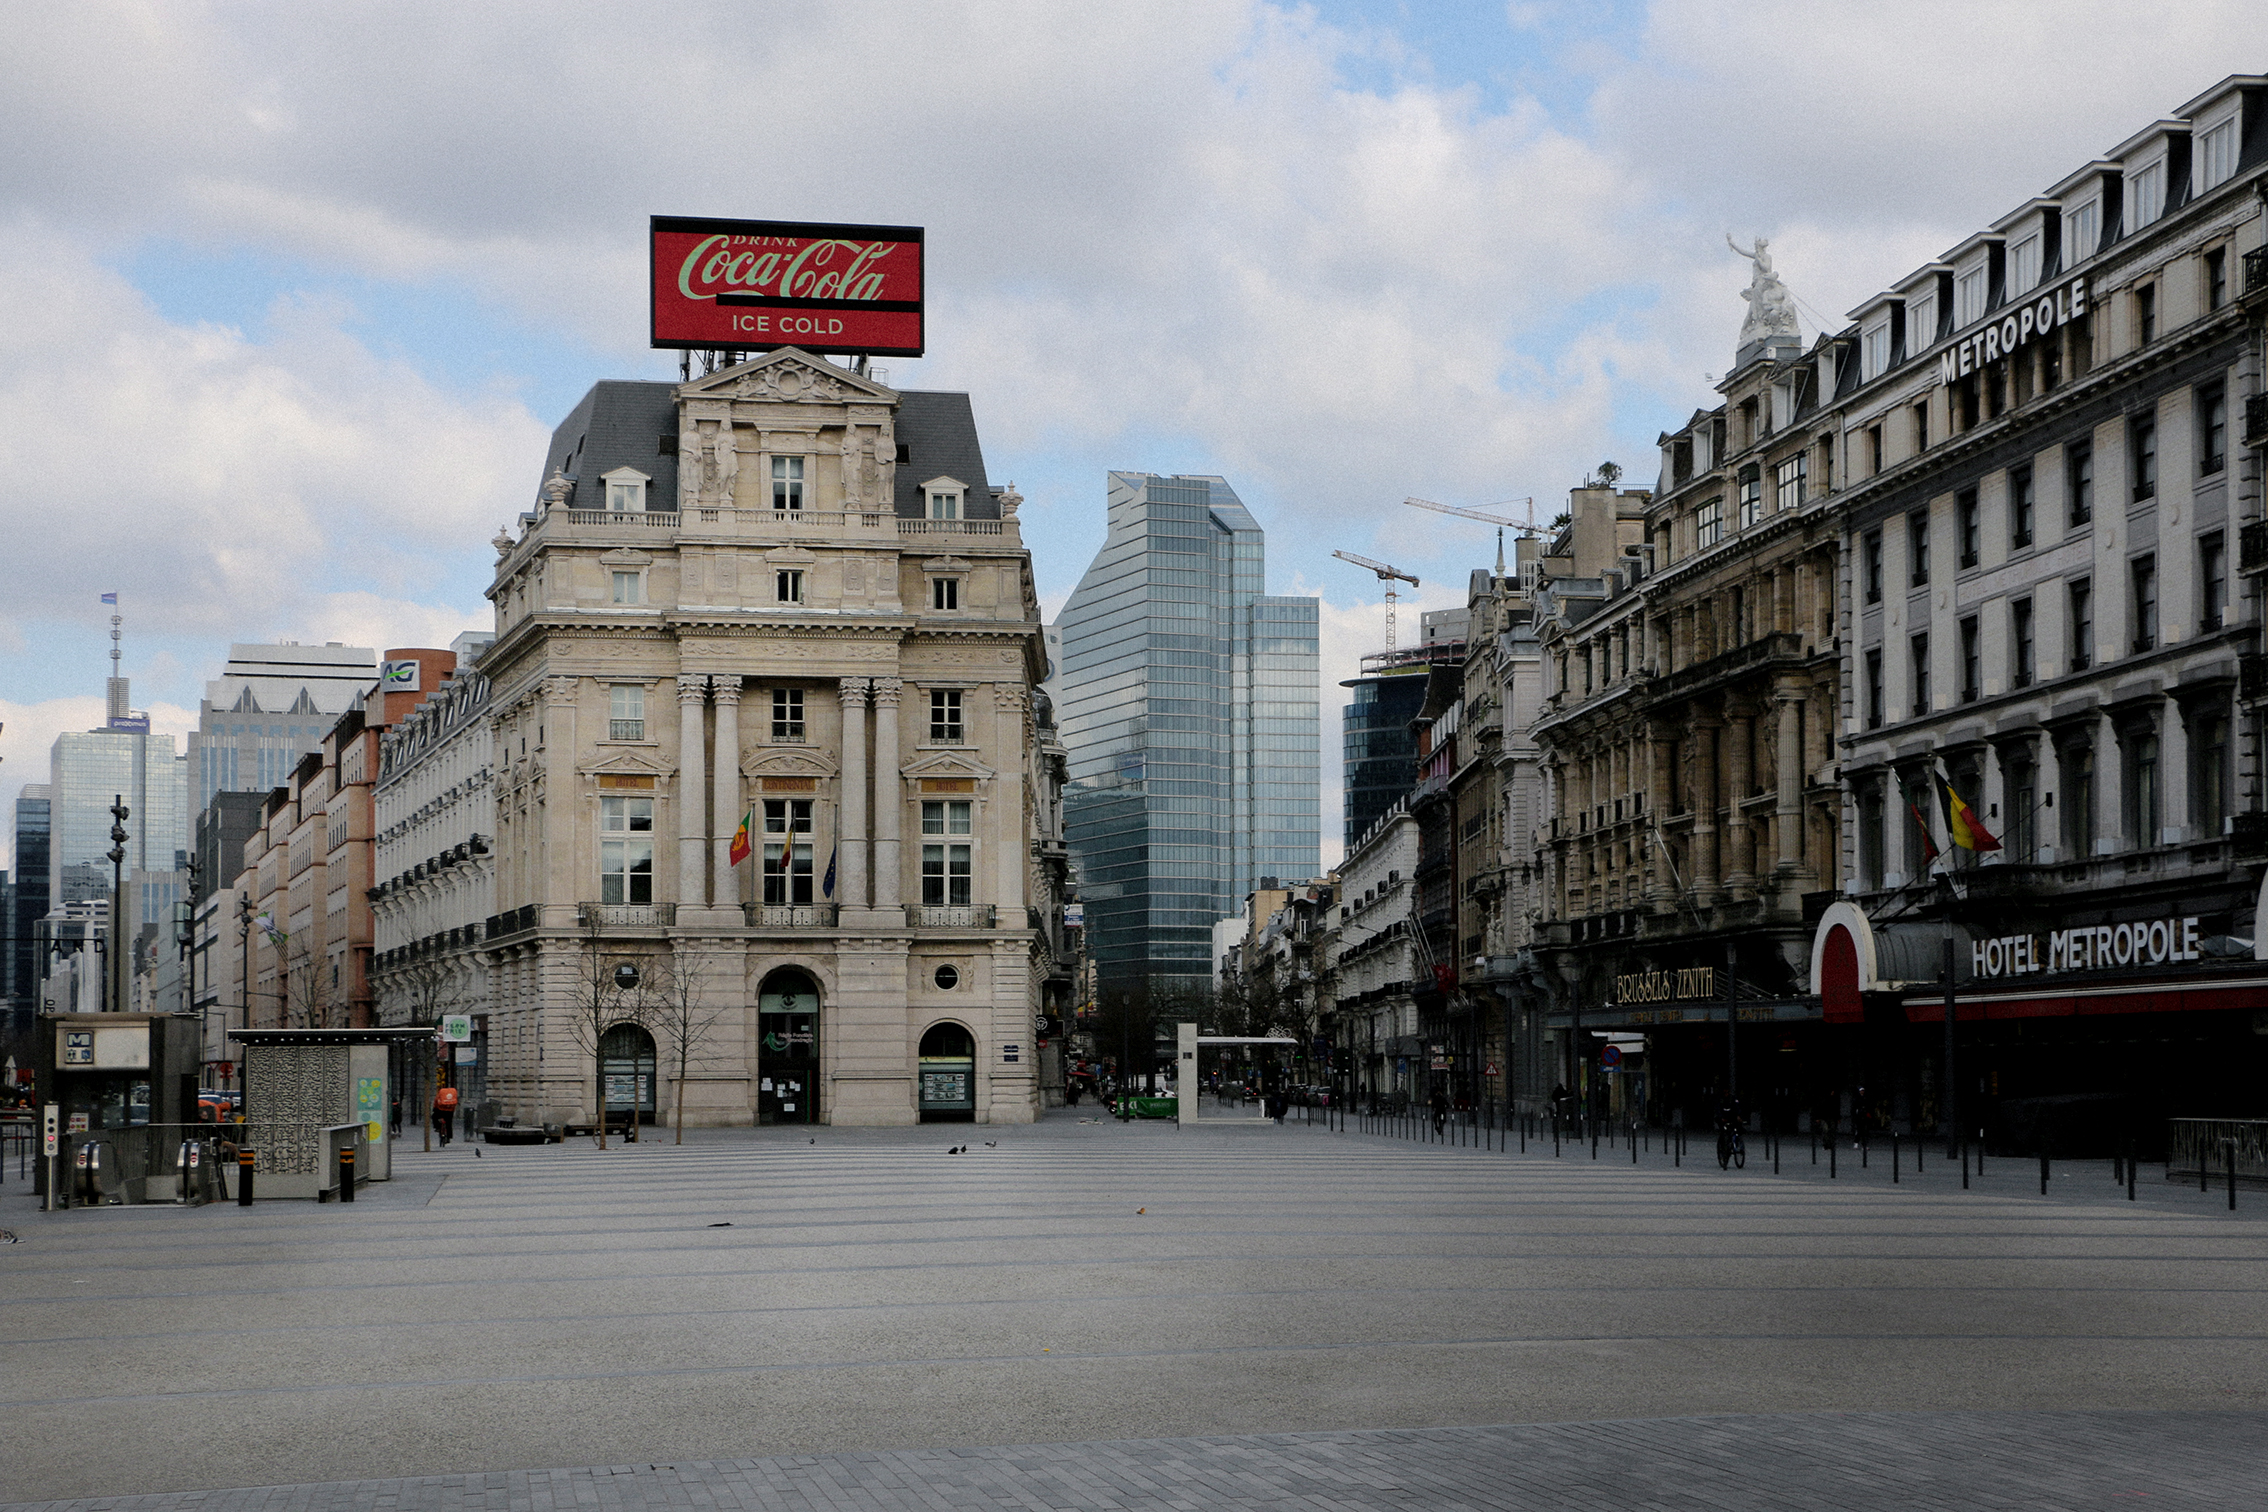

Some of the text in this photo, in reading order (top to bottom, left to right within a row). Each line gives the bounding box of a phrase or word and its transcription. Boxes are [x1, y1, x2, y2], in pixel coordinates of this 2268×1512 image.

[733, 235, 798, 248] DRINK
[678, 235, 897, 300] Coca-Cola
[733, 314, 843, 334] ICE COLD
[1941, 277, 2087, 387] METROPOLE
[382, 662, 416, 683] AG
[113, 720, 147, 729] proximus
[615, 777, 639, 788] HOTEL
[763, 779, 814, 790] CONTINENTAL
[936, 781, 959, 791] HOTEL
[1972, 917, 2200, 978] HOTEL METROPOLE
[1616, 966, 1714, 1004] BRUSSELS ZENITH
[68, 1034, 90, 1046] M
